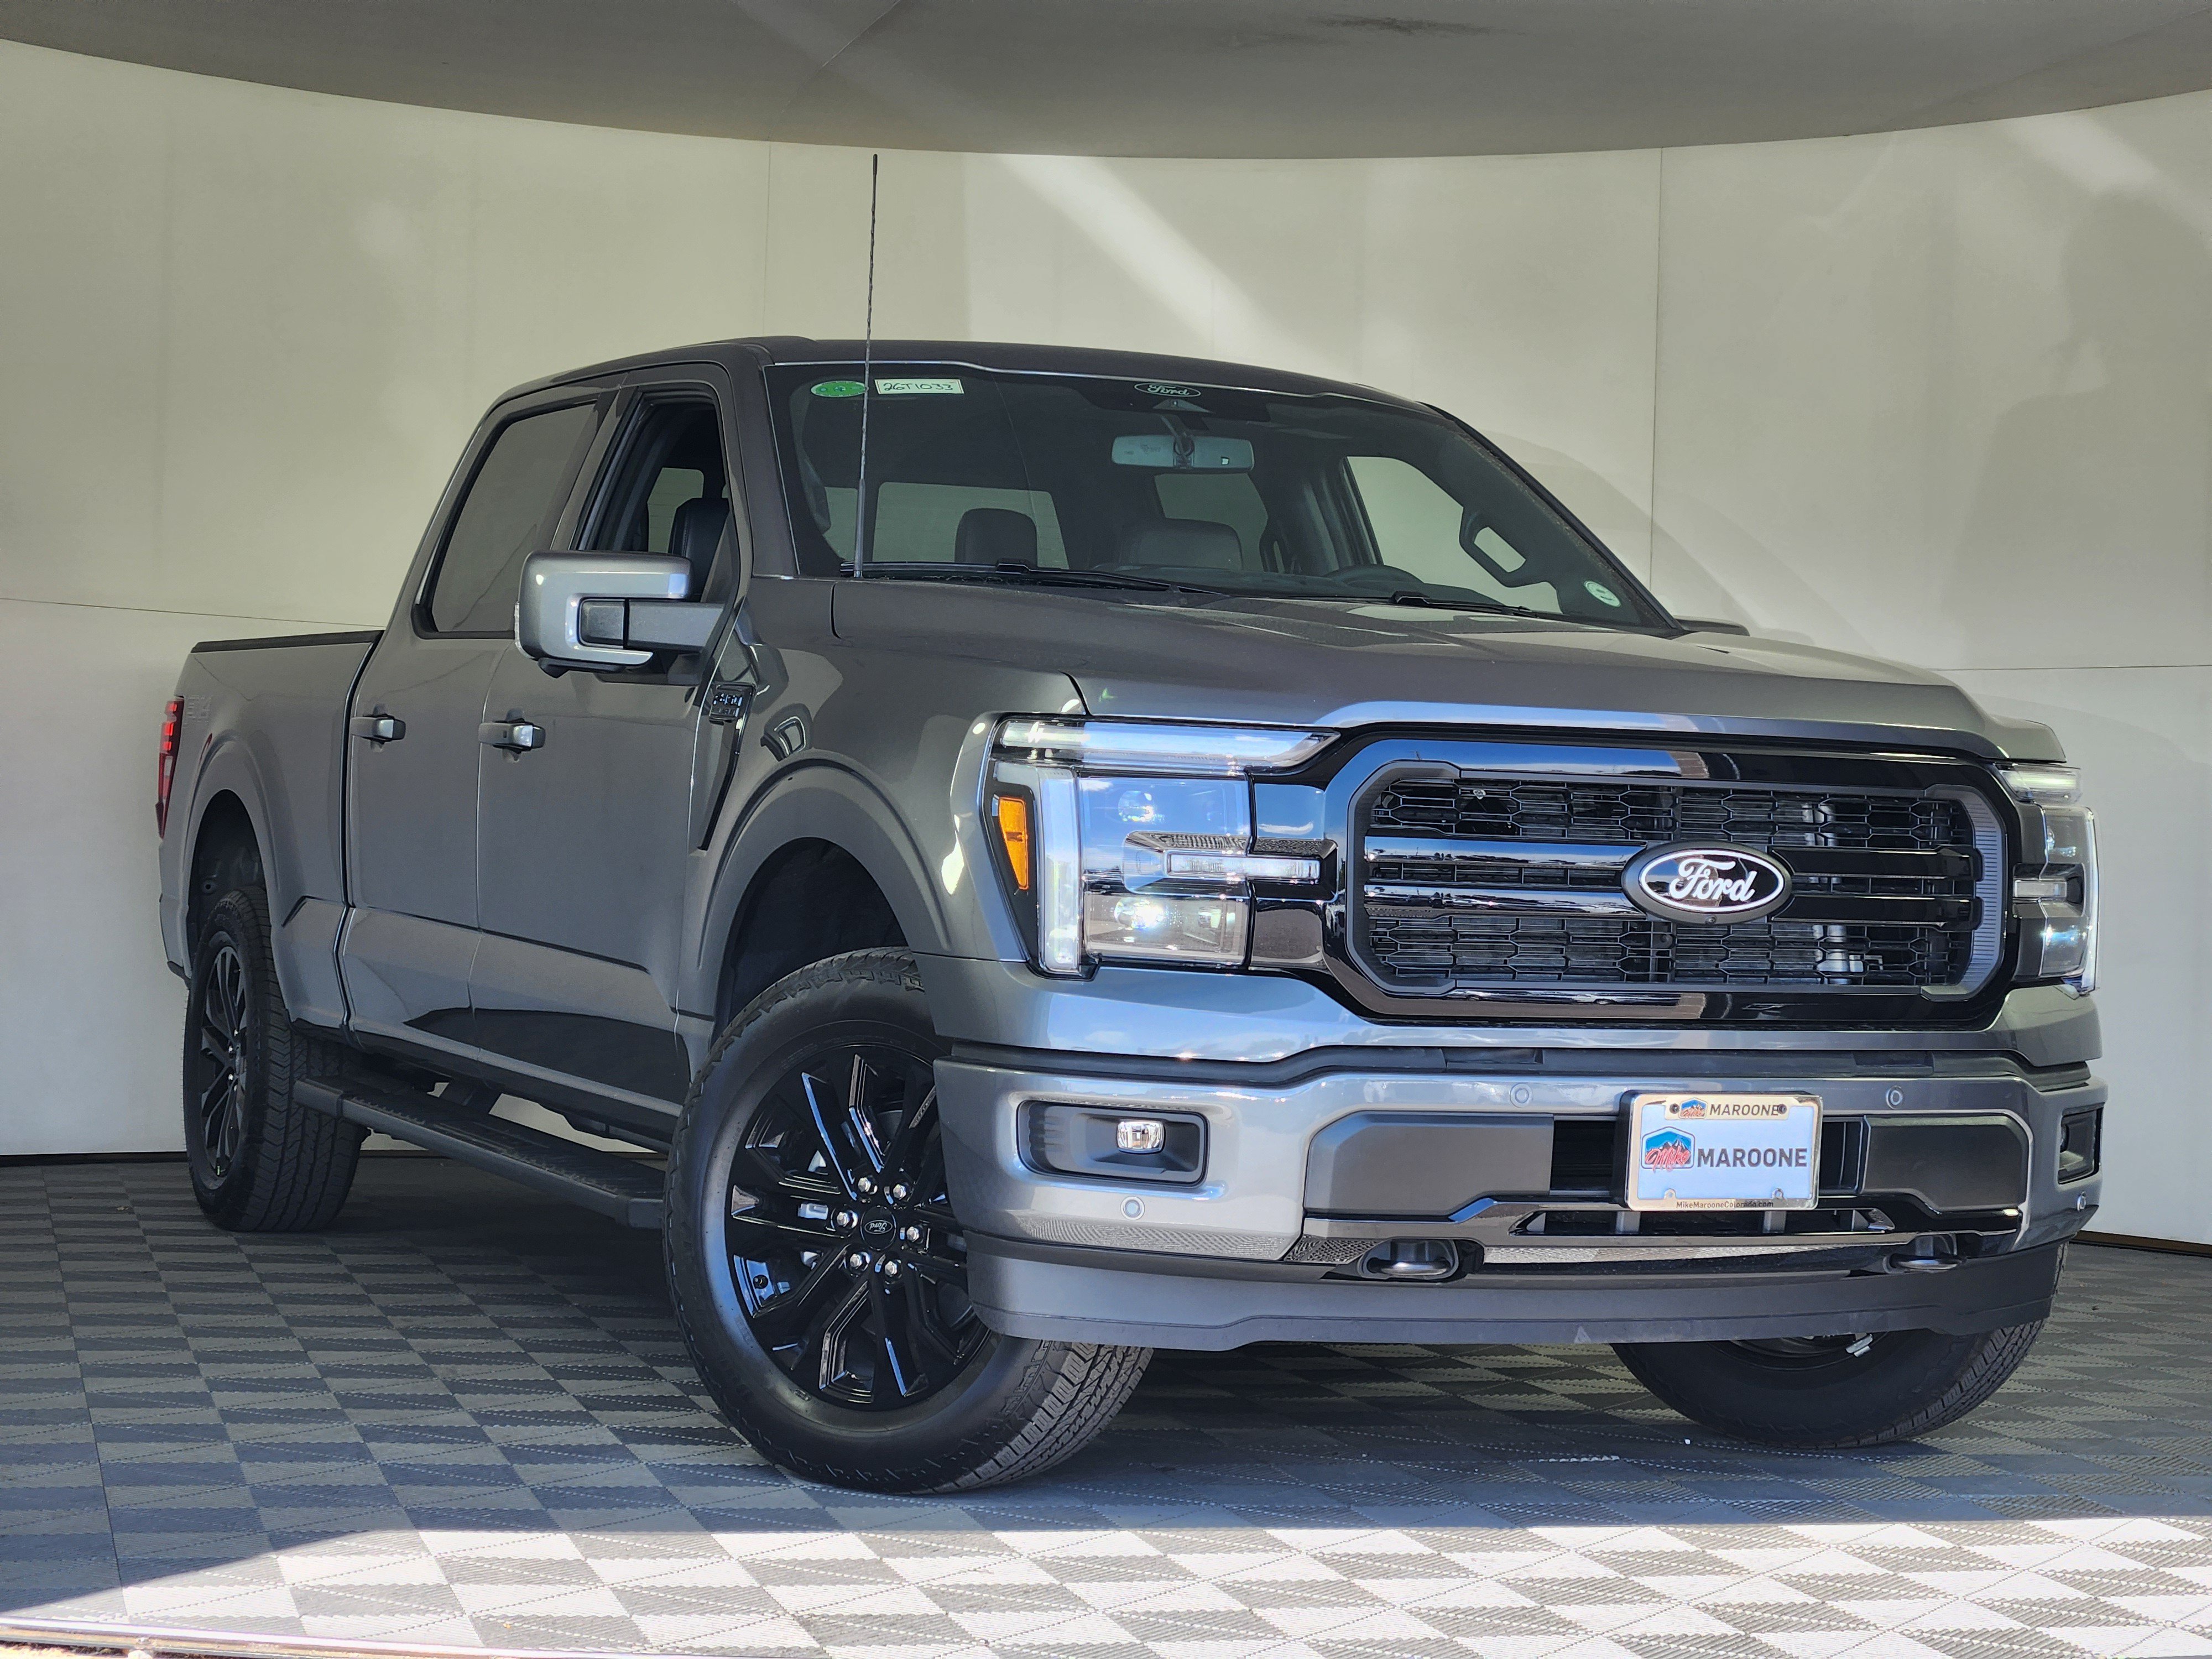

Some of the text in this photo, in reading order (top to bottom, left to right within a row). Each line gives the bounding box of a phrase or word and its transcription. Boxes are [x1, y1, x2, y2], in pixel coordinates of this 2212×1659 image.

[1147, 384, 1190, 395] Ford
[1669, 858, 1758, 901] Ford
[1709, 1104, 1778, 1116] MAROONE
[1645, 1145, 1807, 1172] Mike MAROONE
[869, 1222, 888, 1232] Ford
